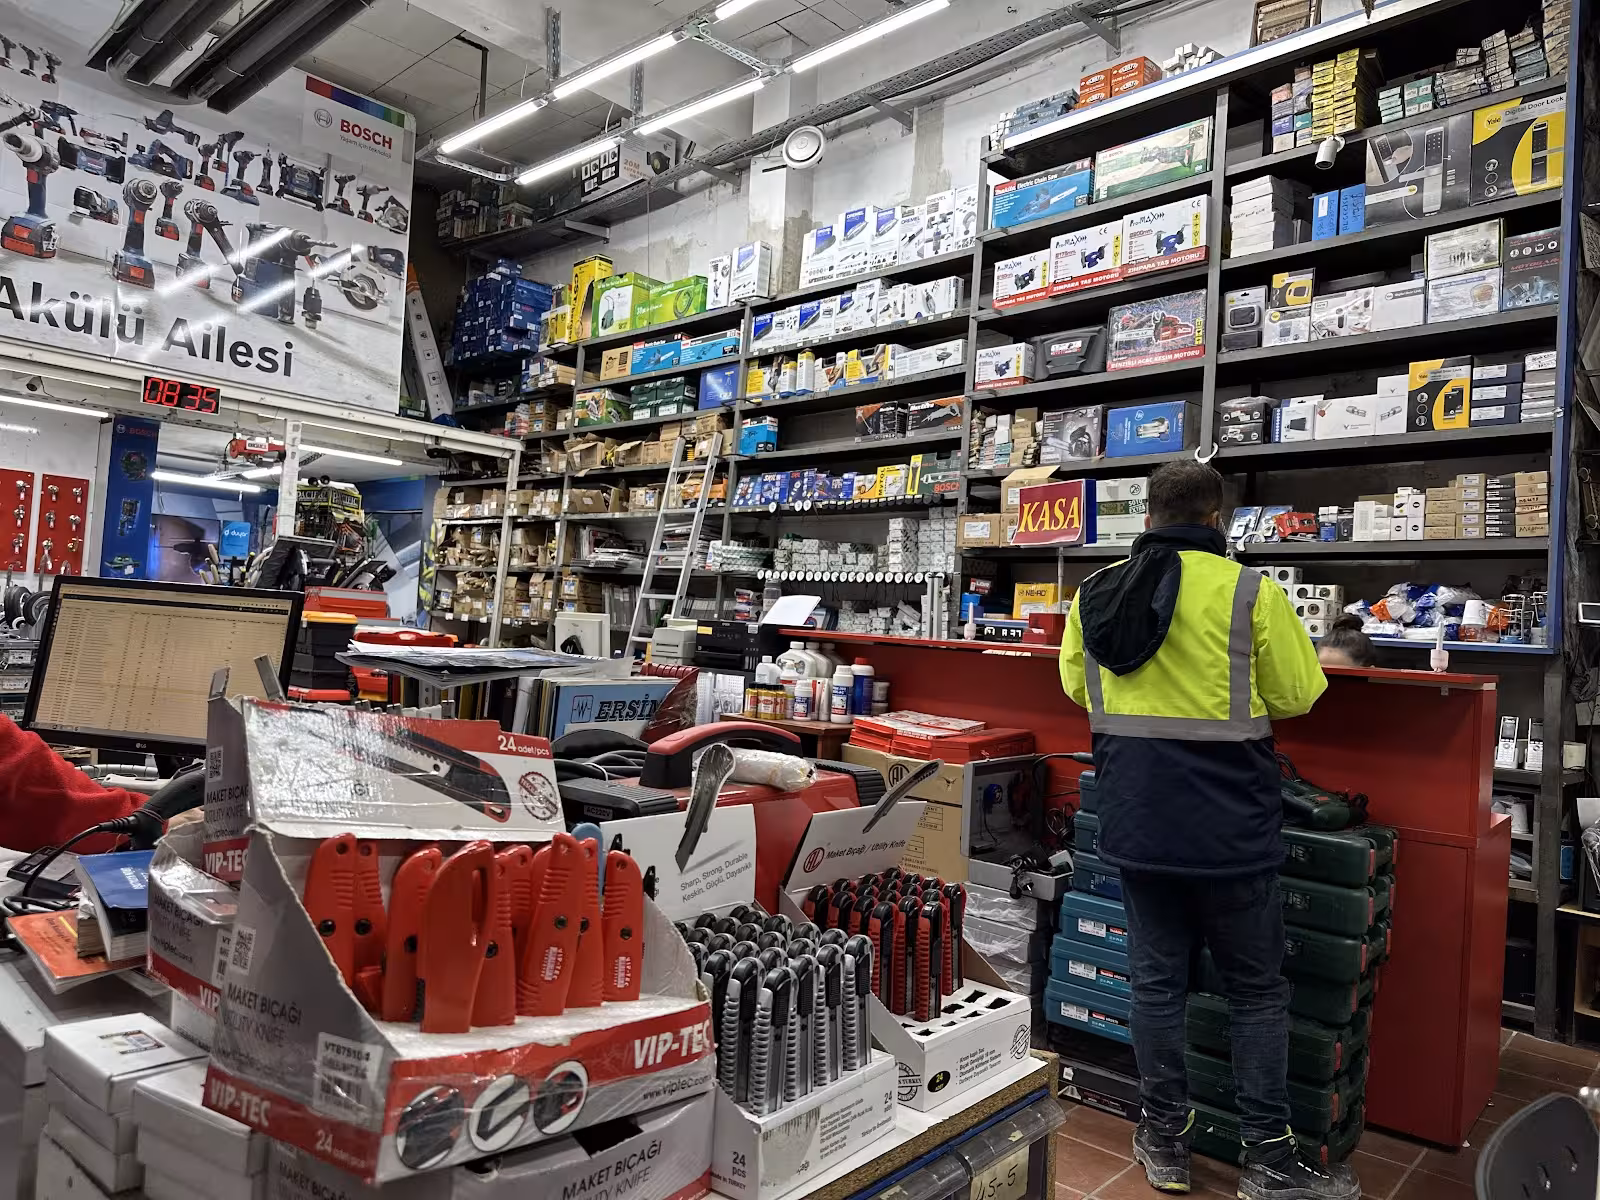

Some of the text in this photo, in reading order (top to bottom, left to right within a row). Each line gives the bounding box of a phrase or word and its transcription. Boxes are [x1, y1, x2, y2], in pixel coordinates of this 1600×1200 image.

[1505, 96, 1564, 116] Digital Door Lock
[1487, 117, 1501, 125] Yale
[340, 119, 393, 150] BOSCH
[1017, 179, 1034, 189] Electric
[901, 215, 920, 225] DREMEL
[1171, 252, 1200, 263] MOTORU
[0, 275, 294, 378] Akülü Ailesi
[129, 428, 158, 438] BOSCH
[934, 482, 960, 492] BOSCH
[1018, 496, 1081, 533] KASA
[231, 529, 248, 538] duyar
[498, 735, 517, 752] 24
[205, 787, 228, 804] MAKET
[226, 803, 245, 818] KNIFE
[825, 848, 847, 859] Maket
[871, 842, 889, 852] Utility
[889, 839, 906, 849] Knife
[680, 877, 701, 892] Sharp,
[725, 852, 748, 869] Durable
[227, 982, 258, 1010] MAKET
[634, 1019, 711, 1070] VIP-TEC
[210, 1077, 271, 1127] VIP-TEC
[884, 1090, 893, 1104] 24
[315, 1129, 334, 1152] 24
[732, 1151, 746, 1168] 24
[279, 1160, 309, 1190] MAKET
[562, 1140, 662, 1200] MAKET BIÇAĞI
[732, 1167, 747, 1179] pcs
[616, 1166, 652, 1198] KNIFE
[728, 1178, 746, 1191] TURKEY
